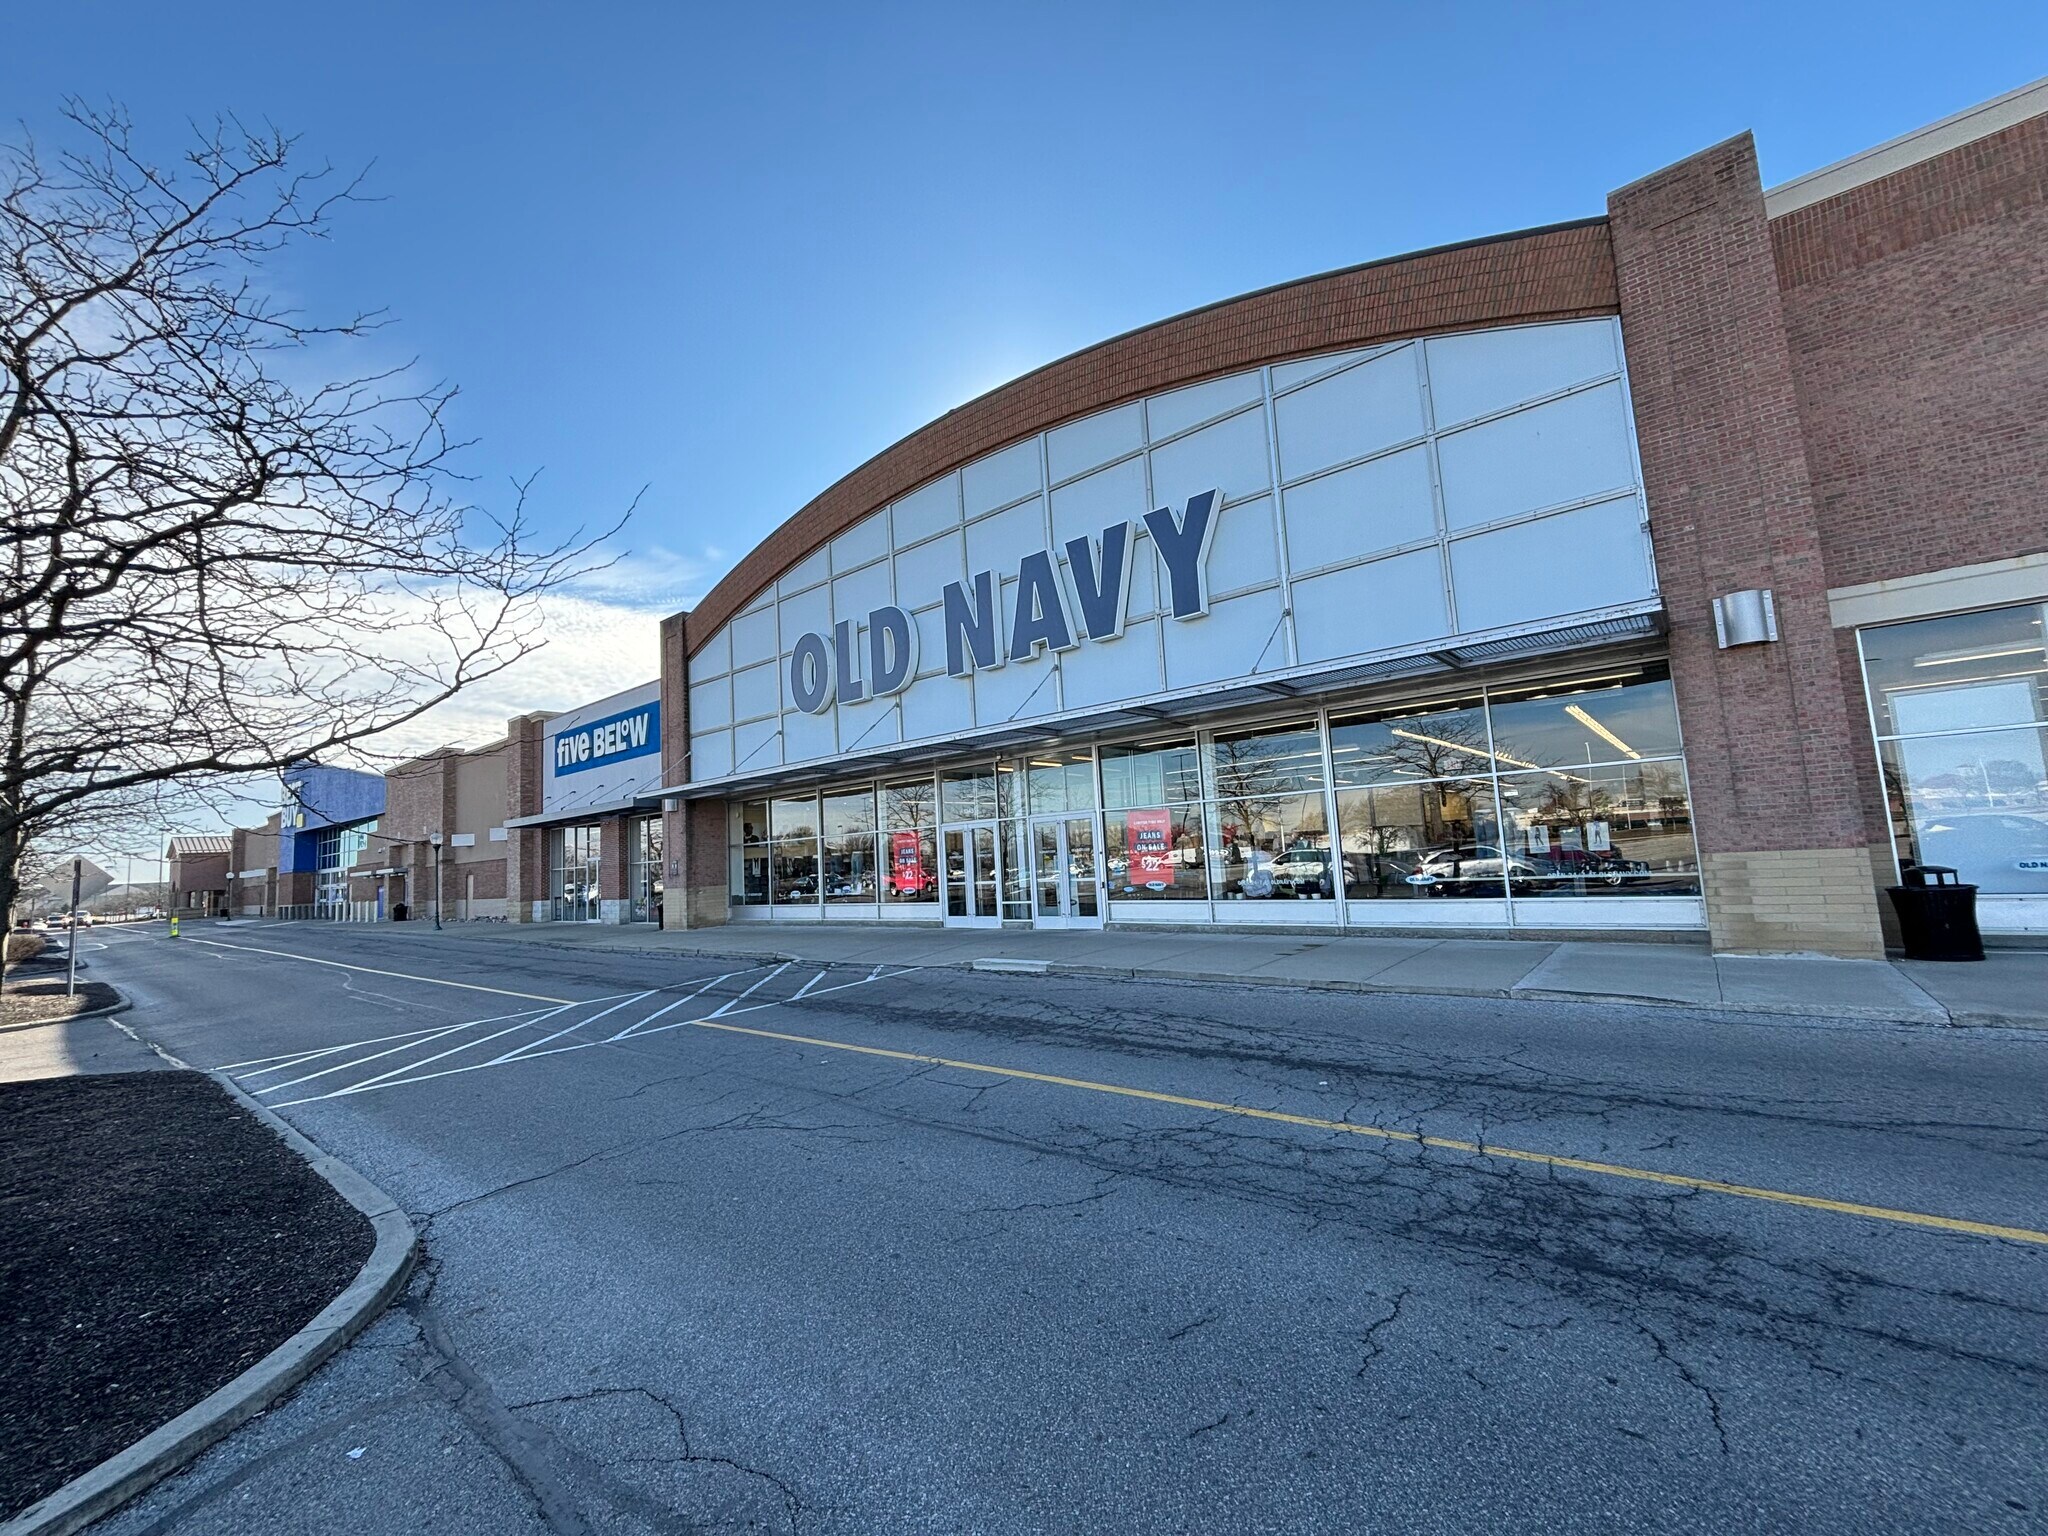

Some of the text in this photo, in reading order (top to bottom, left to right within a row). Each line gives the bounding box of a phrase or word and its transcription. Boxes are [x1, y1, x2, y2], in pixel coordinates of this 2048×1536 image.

[790, 487, 1225, 716] OLD NAVY
[557, 713, 649, 767] five BELOW
[281, 804, 298, 828] BUY
[1139, 831, 1161, 840] JEANS
